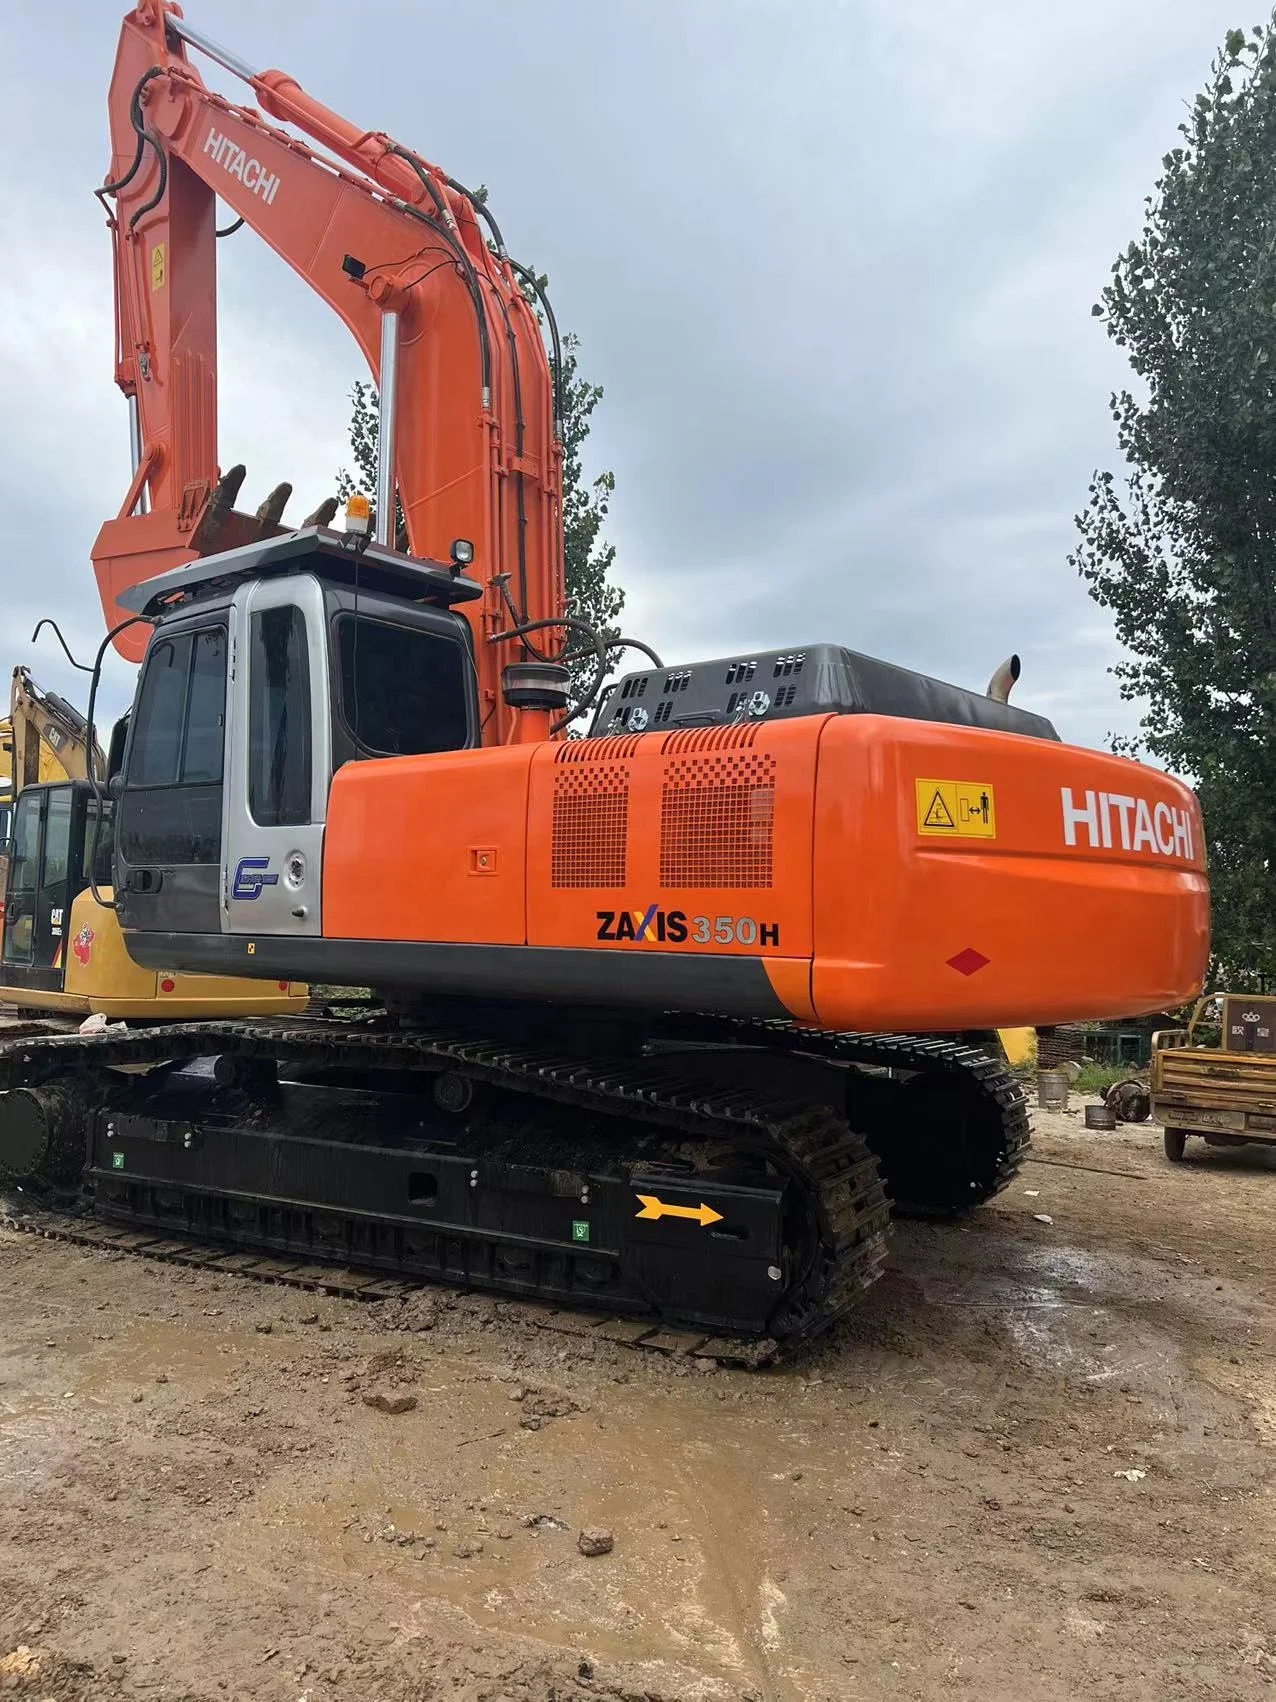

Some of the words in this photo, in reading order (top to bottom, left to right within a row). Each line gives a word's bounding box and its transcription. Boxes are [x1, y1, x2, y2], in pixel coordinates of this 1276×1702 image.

[203, 127, 280, 205] HITACHI
[49, 727, 60, 748] CAT
[1061, 787, 1194, 860] HITACHI
[51, 908, 64, 925] CAT
[596, 904, 688, 943] ZAXIS
